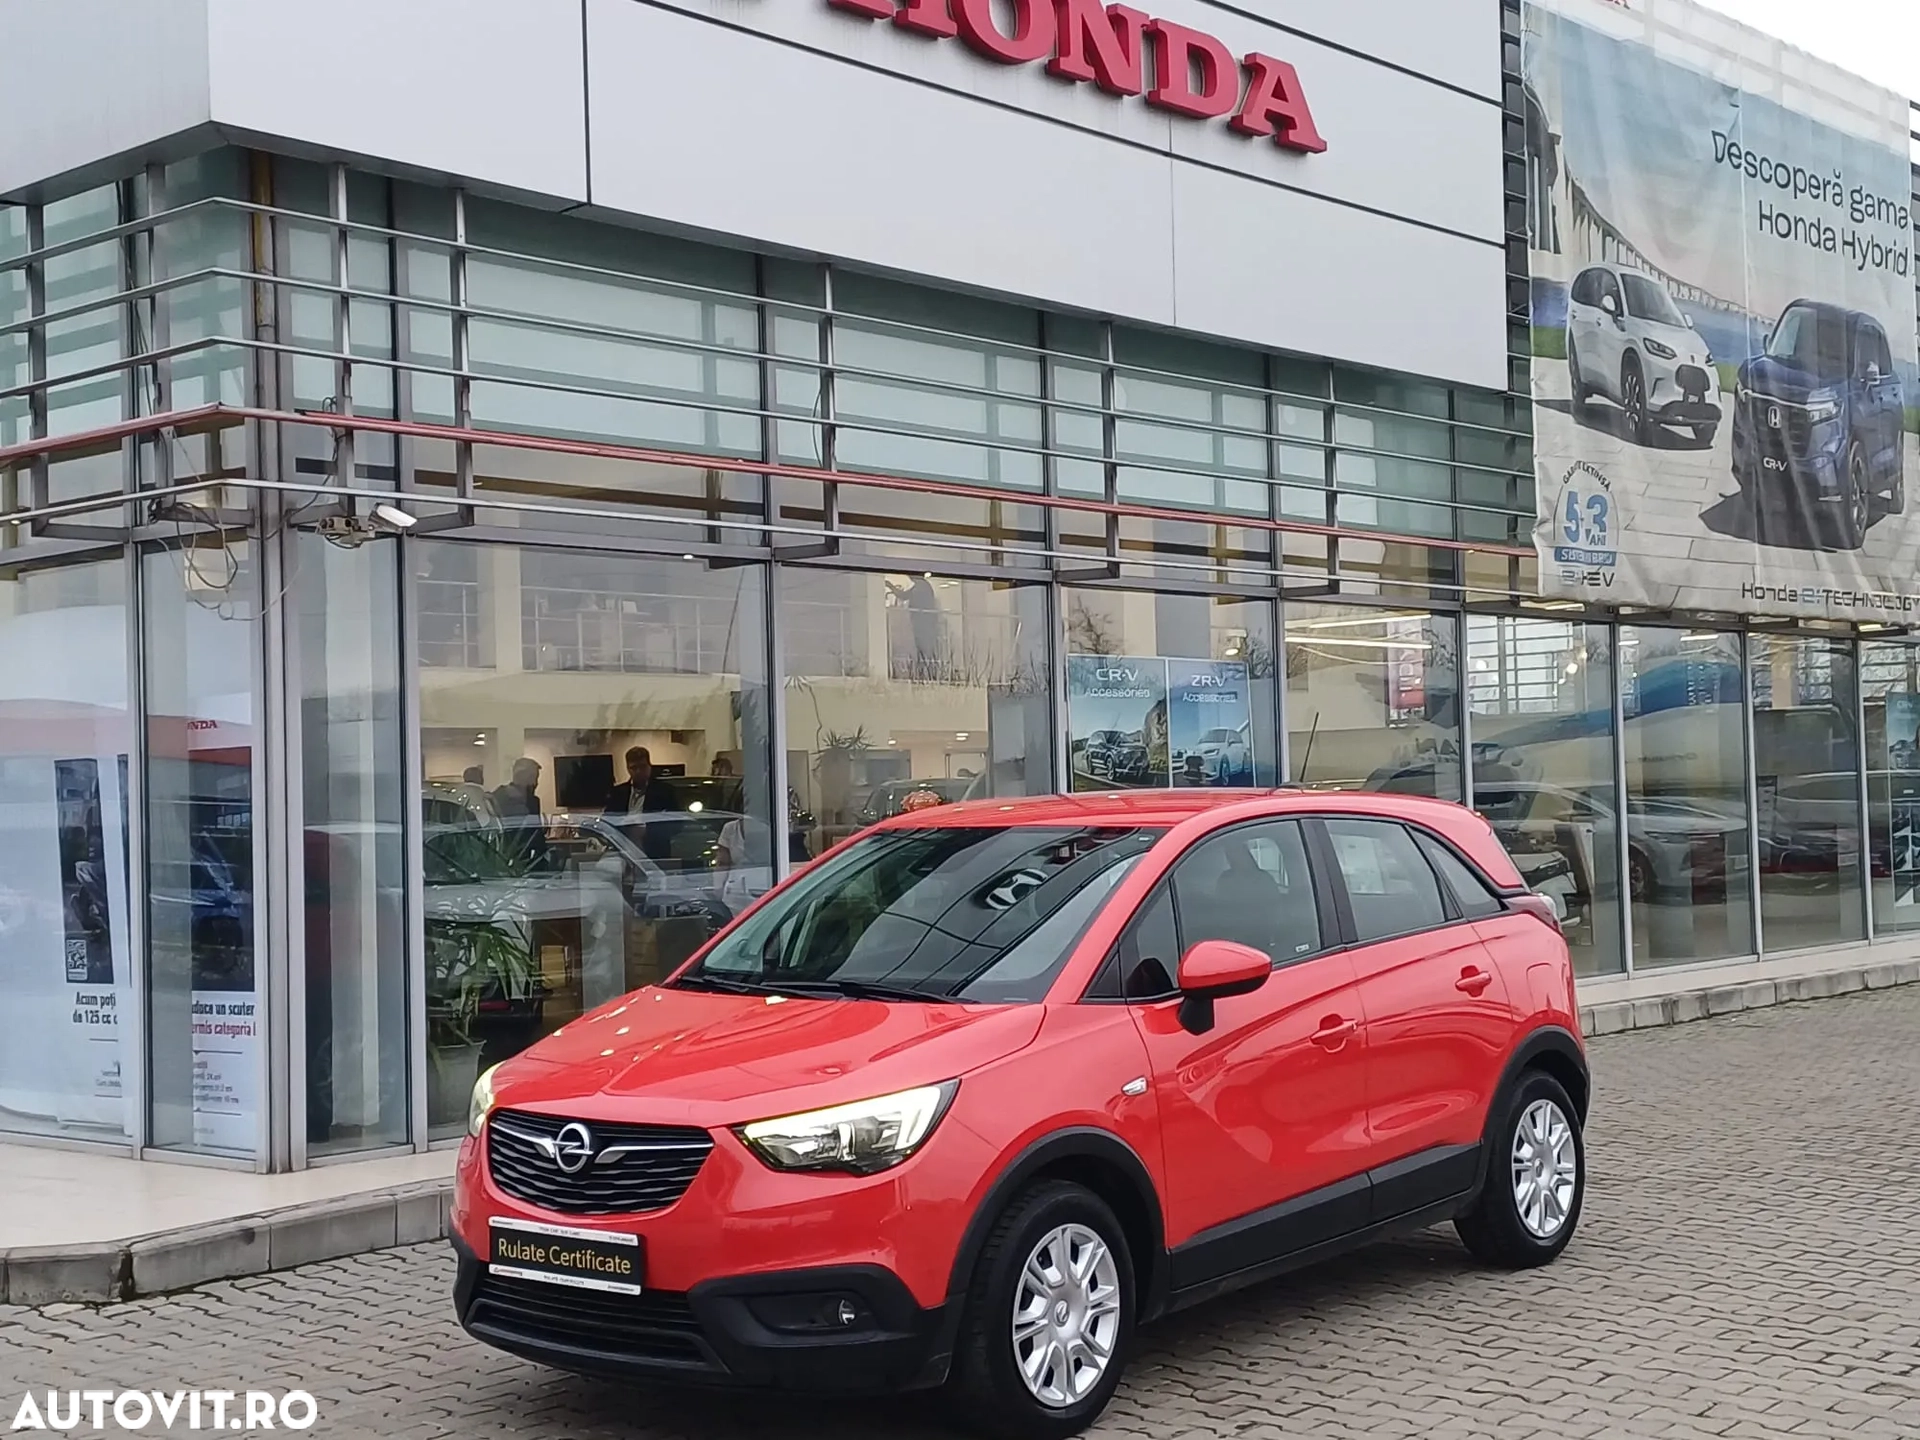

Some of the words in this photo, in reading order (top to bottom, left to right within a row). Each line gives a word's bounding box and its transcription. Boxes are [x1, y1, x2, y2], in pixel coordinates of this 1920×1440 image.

[1711, 130, 1844, 208] Descoperă
[1850, 185, 1909, 230] gama
[1759, 200, 1837, 253] Honda
[1842, 229, 1909, 277] Hybrid
[1190, 674, 1227, 688] ZR-V
[84, 1009, 100, 1024] 125
[228, 1001, 255, 1017] scuter
[498, 1238, 546, 1263] Rulate
[549, 1246, 631, 1275] Certificate
